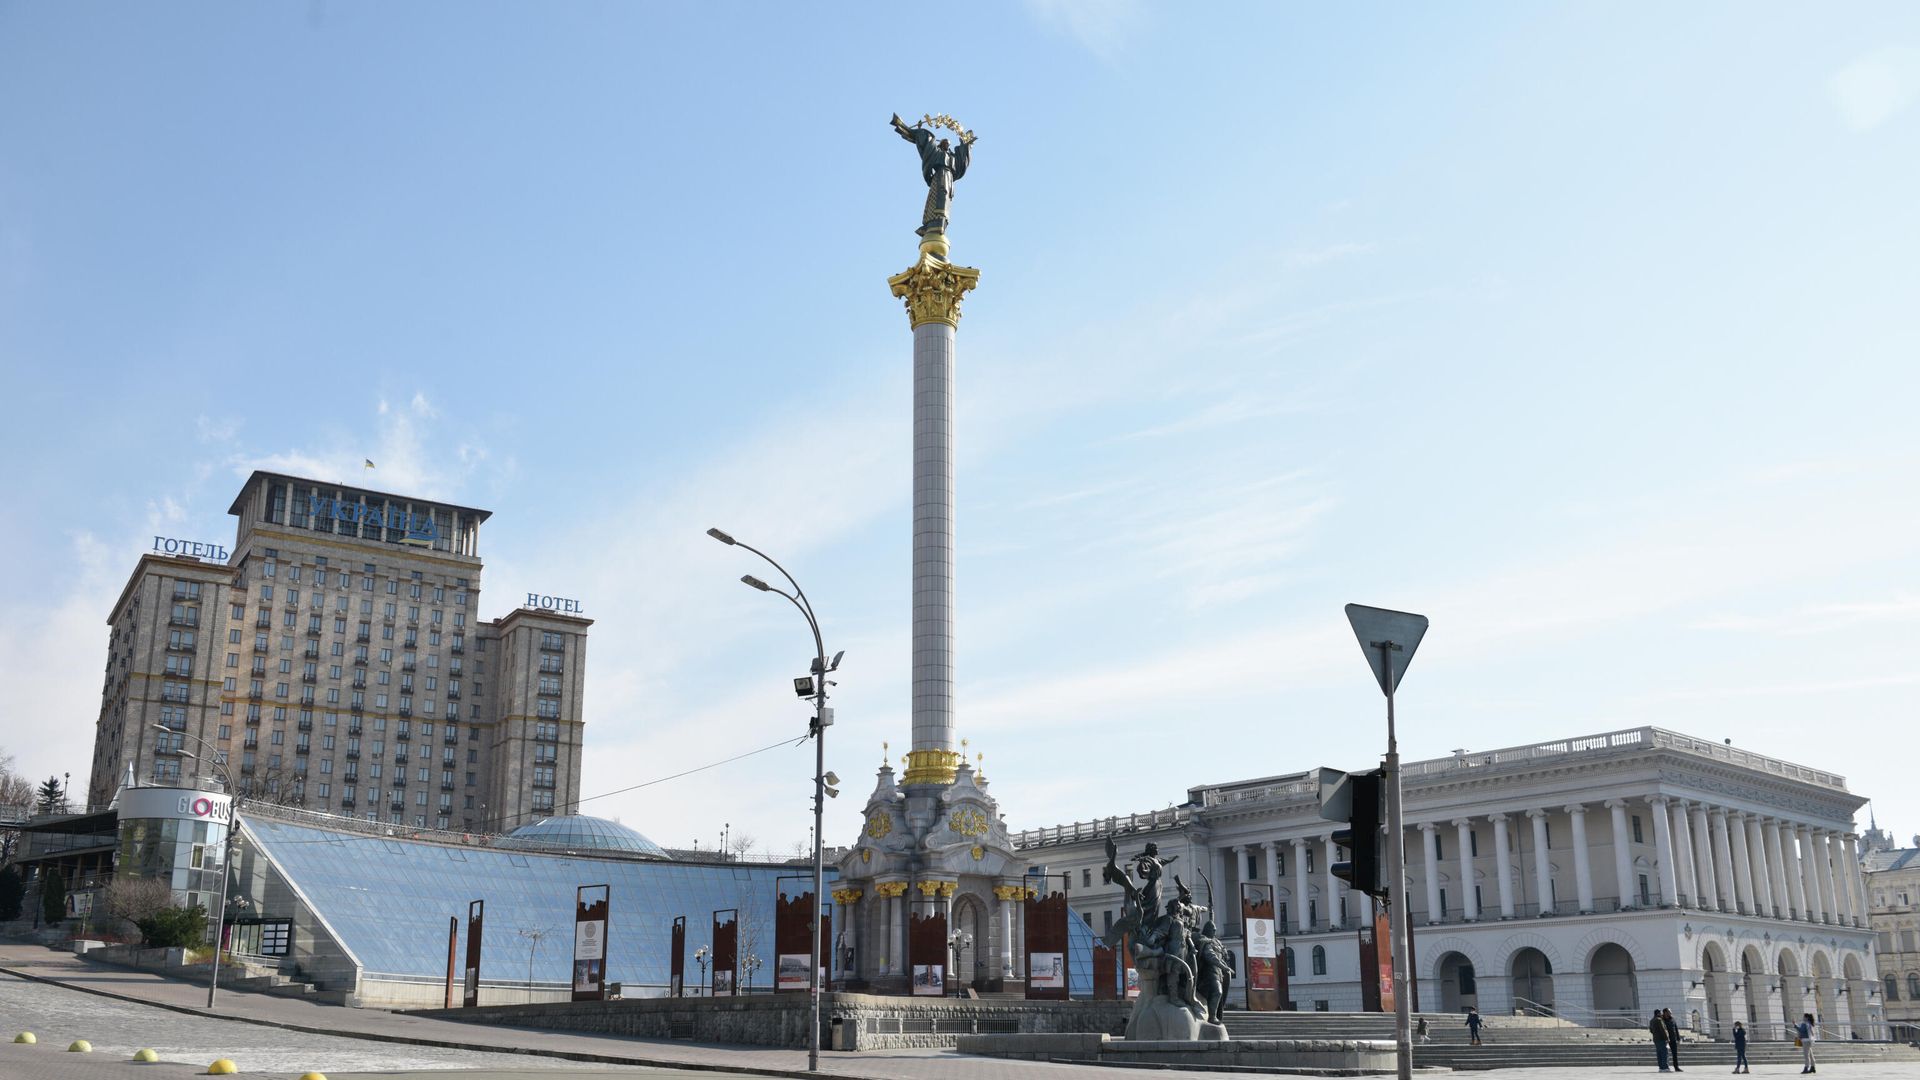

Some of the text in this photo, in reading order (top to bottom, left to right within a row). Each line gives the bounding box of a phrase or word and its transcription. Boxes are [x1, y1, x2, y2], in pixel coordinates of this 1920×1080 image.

[308, 495, 438, 535] УКРАЇНА
[153, 536, 229, 559] ГОТЕЛЬ
[527, 593, 583, 613] HOTEL
